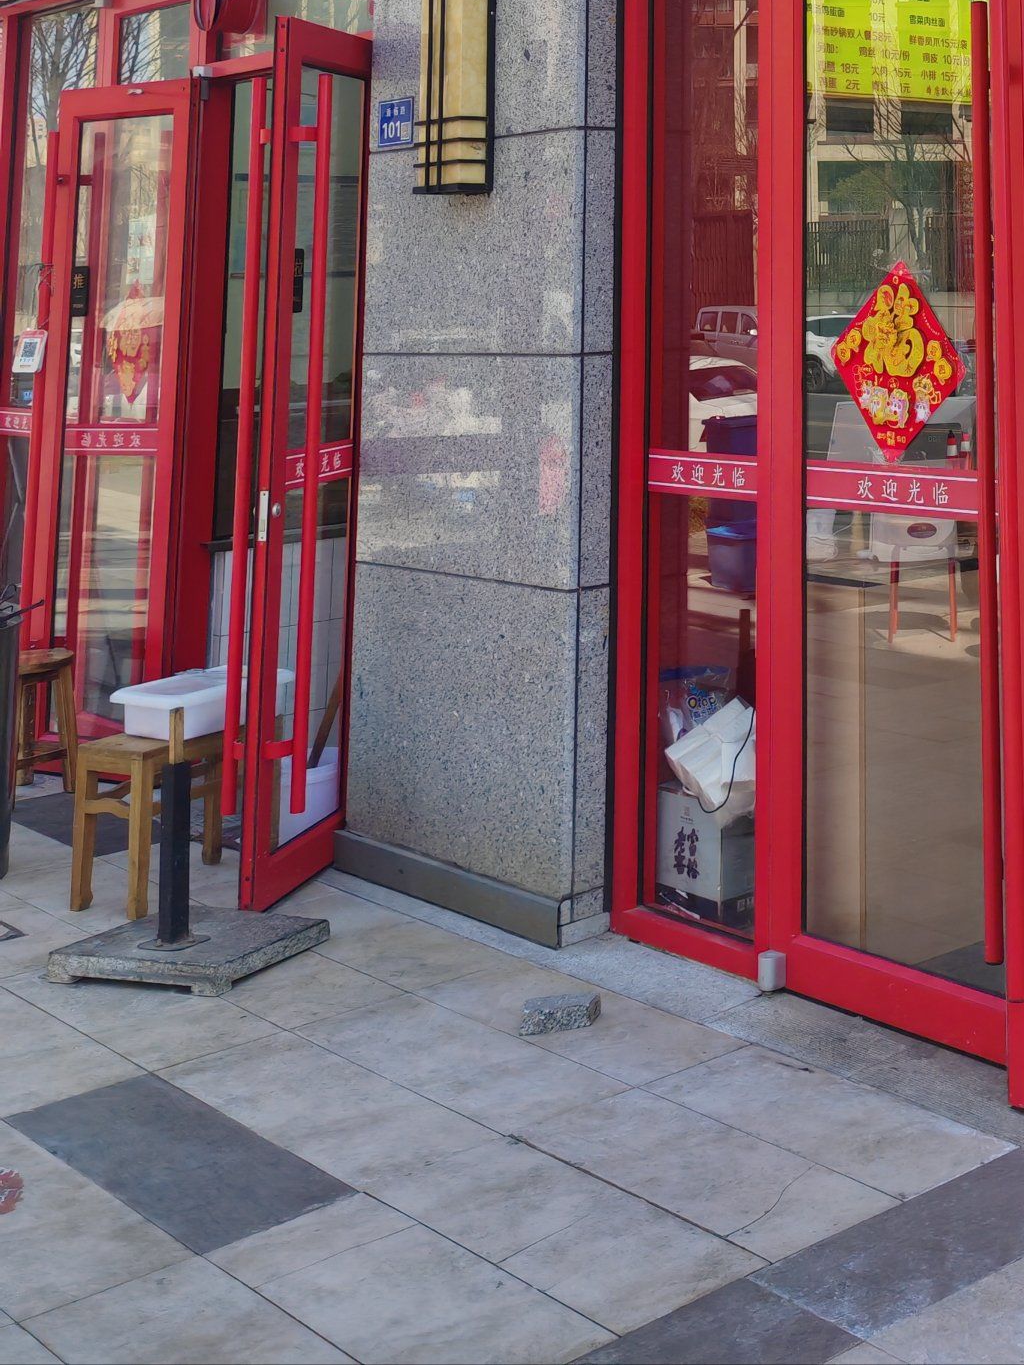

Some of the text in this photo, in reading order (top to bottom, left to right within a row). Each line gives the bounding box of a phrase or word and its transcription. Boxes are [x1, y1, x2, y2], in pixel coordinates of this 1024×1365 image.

[840, 63, 860, 75] 18元
[845, 79, 861, 91] 2元
[382, 120, 400, 140] 101
[5, 414, 31, 430] 欢迎光
[295, 453, 341, 478] 欢光临
[671, 460, 746, 488] 欢迎光临
[856, 476, 950, 507] 欢迎光临
